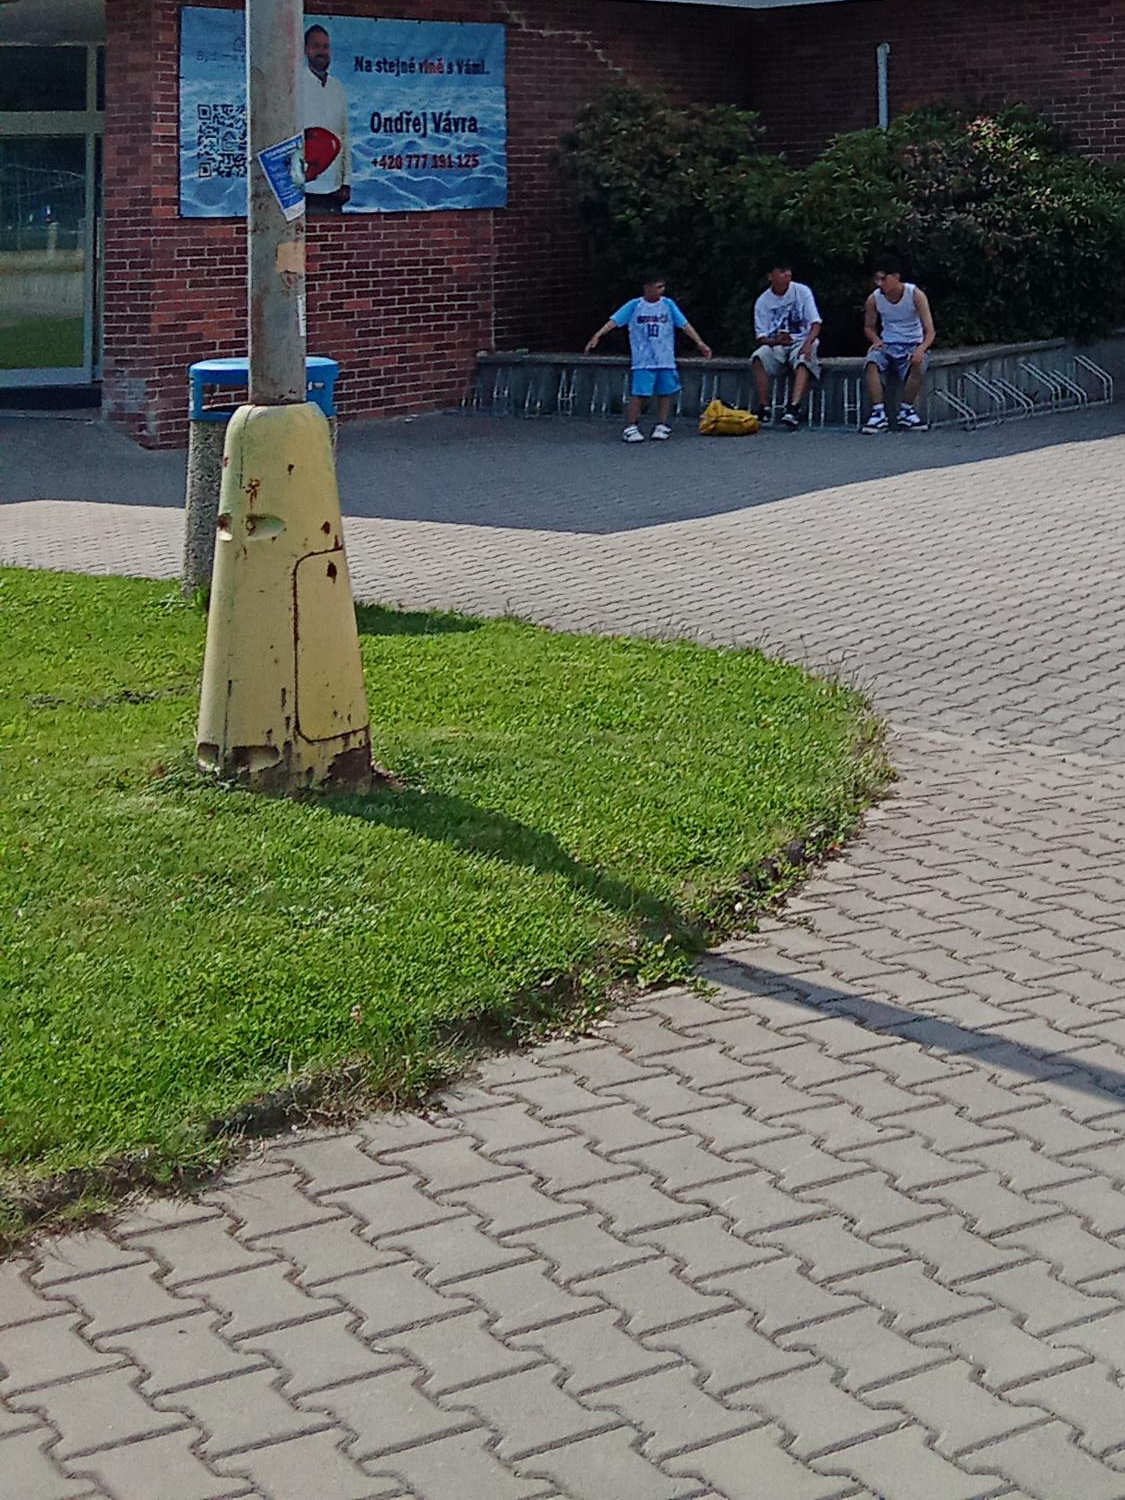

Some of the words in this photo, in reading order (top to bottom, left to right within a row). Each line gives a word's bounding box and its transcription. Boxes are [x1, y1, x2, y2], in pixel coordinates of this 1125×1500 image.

[354, 56, 372, 73] Na
[375, 57, 416, 77] stejné
[447, 62, 454, 74] s
[371, 109, 427, 138] Ondřej
[431, 110, 478, 133] Vávra
[371, 154, 402, 170] +420
[406, 154, 428, 169] 777
[457, 154, 480, 168] 125
